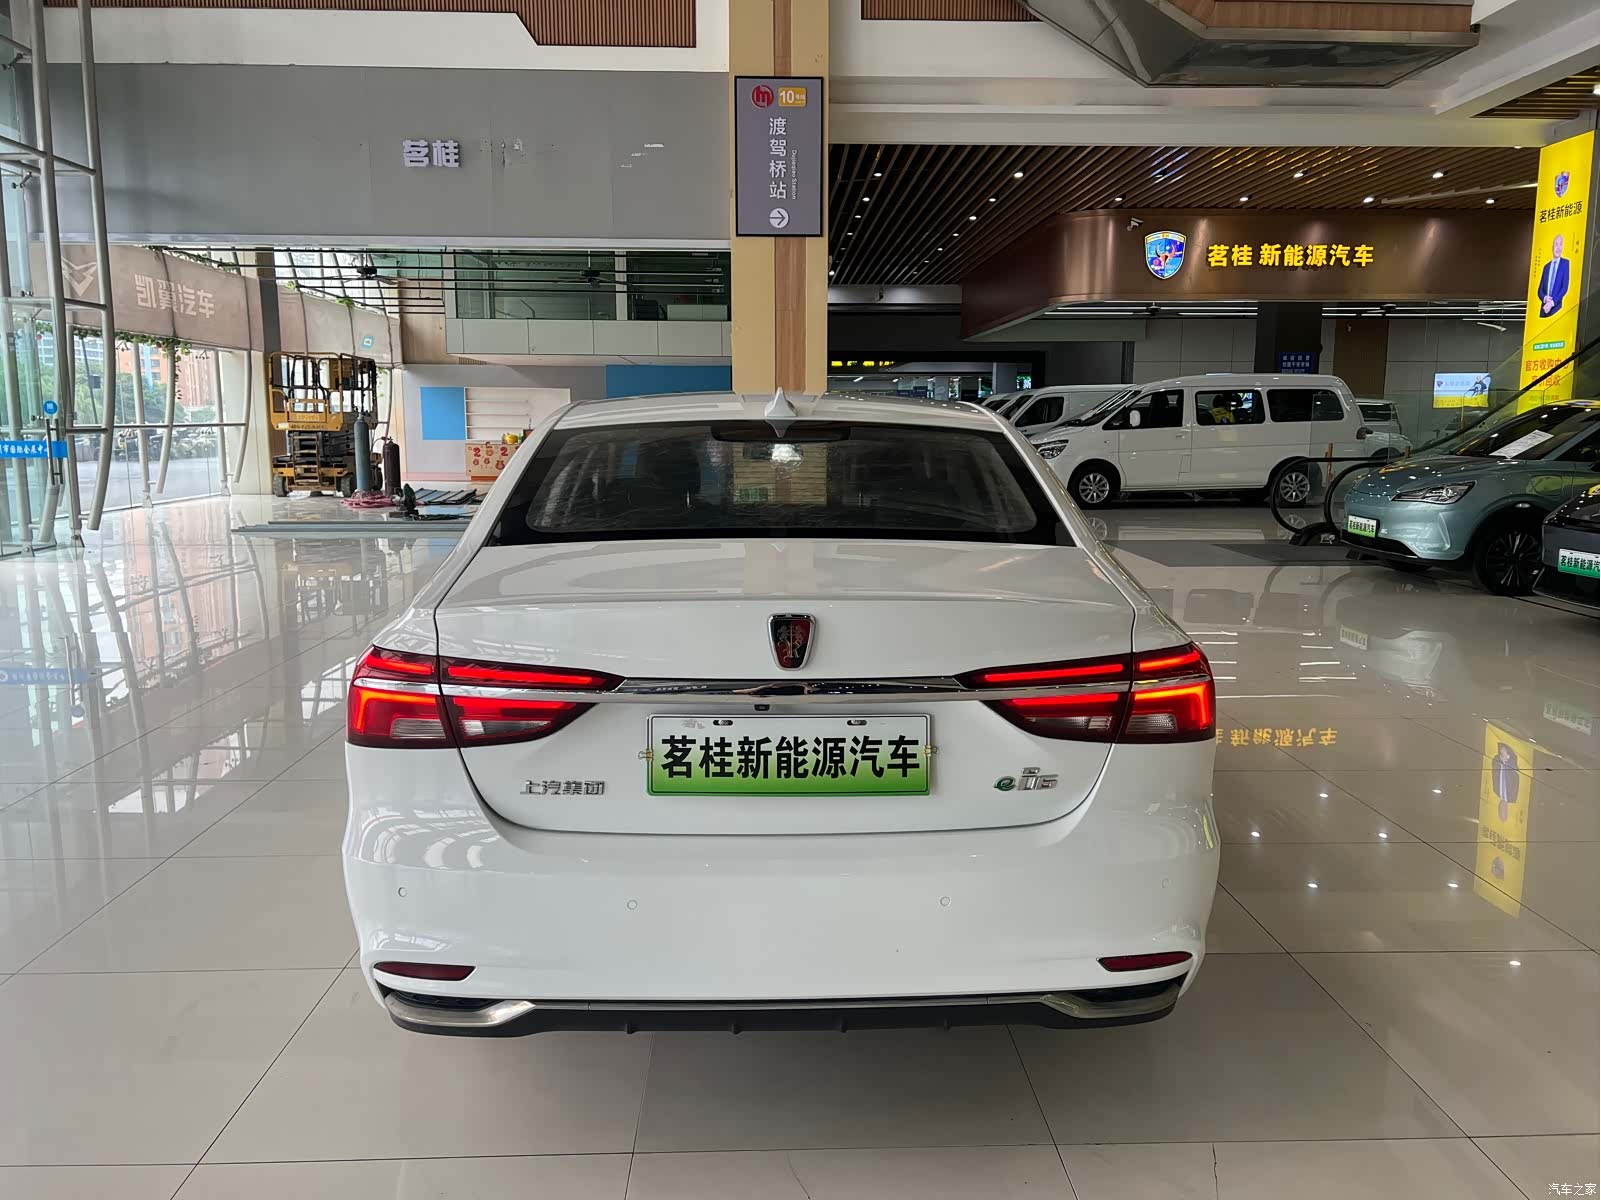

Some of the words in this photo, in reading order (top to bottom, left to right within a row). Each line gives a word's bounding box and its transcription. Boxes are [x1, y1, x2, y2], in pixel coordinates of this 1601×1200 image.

[402, 139, 460, 168] 茗桂
[769, 117, 787, 200] 渡驾桥站
[1539, 201, 1583, 224] 茗桂新能源
[1207, 245, 1253, 267] 茗桂
[1259, 244, 1374, 267] 新能源汽车
[135, 273, 215, 318] 凯翼汽车
[0, 443, 48, 455] 市国际会展中
[660, 735, 920, 780] 茗桂新能源汽车
[520, 780, 605, 795] 上汽集团
